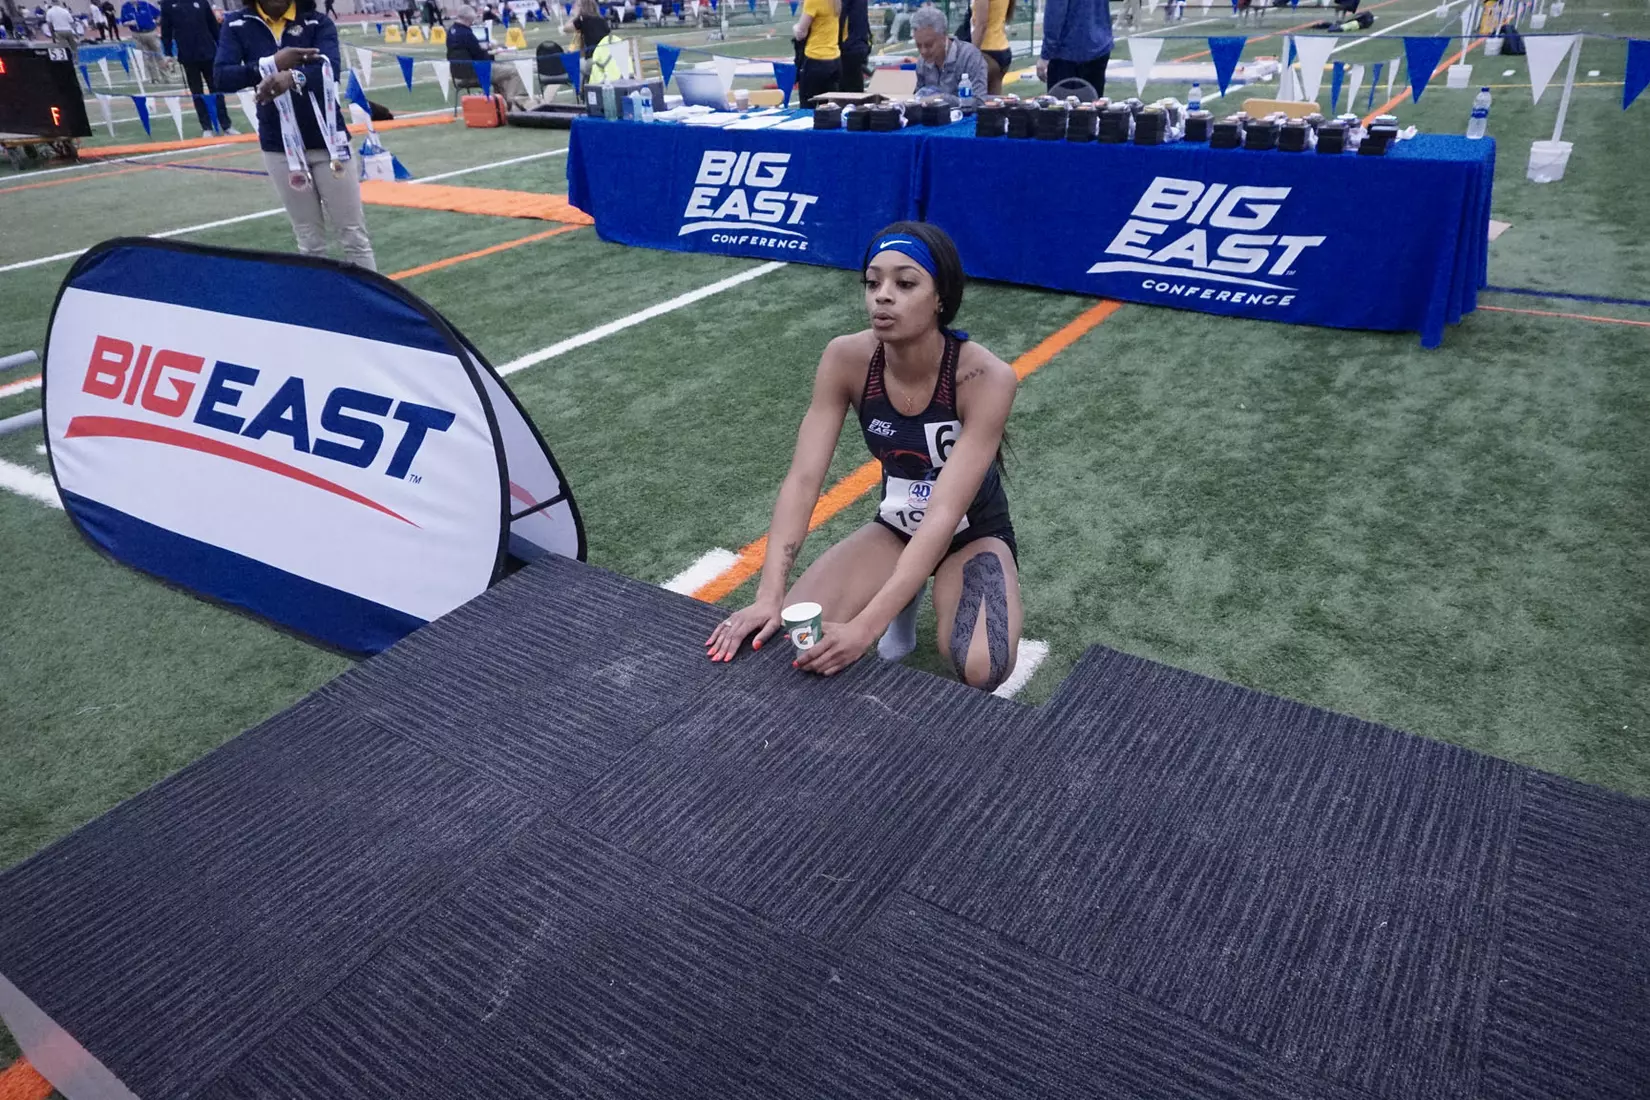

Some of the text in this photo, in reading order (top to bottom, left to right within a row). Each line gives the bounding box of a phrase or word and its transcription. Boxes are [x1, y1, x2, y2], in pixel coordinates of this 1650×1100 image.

[695, 150, 791, 188] BIG
[684, 187, 819, 224] EAST
[1130, 176, 1293, 231] BIG
[711, 234, 809, 251] CONFERENCE
[1104, 218, 1327, 276] EAST
[1141, 279, 1296, 306] CONFERENCE
[868, 423, 897, 437] EAST
[871, 418, 892, 429] BIG
[935, 424, 957, 463] 6
